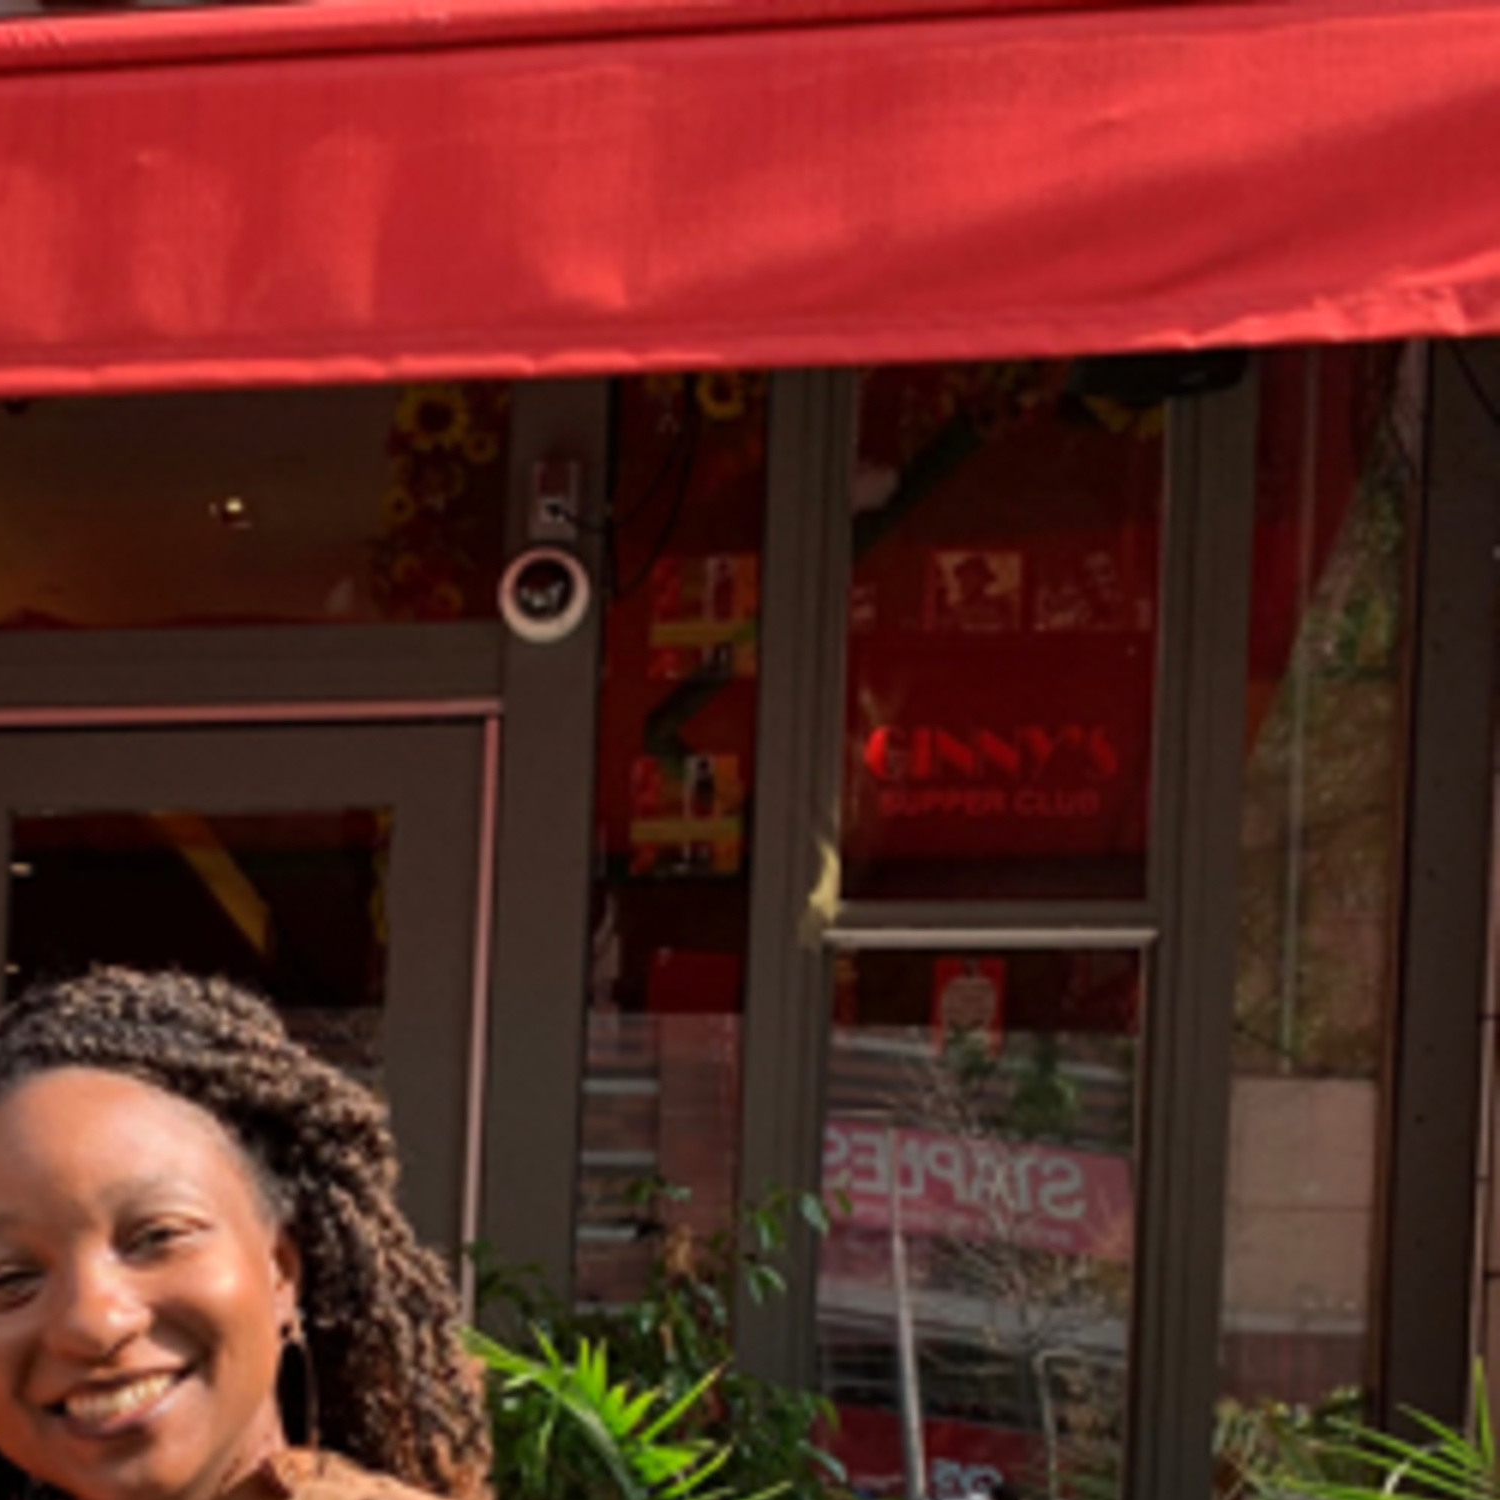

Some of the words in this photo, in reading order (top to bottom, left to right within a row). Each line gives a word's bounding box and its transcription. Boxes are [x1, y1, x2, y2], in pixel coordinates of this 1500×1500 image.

[861, 724, 1119, 779] GINNY'S
[879, 787, 1006, 817] SUPPER
[1012, 787, 1100, 817] CLUB
